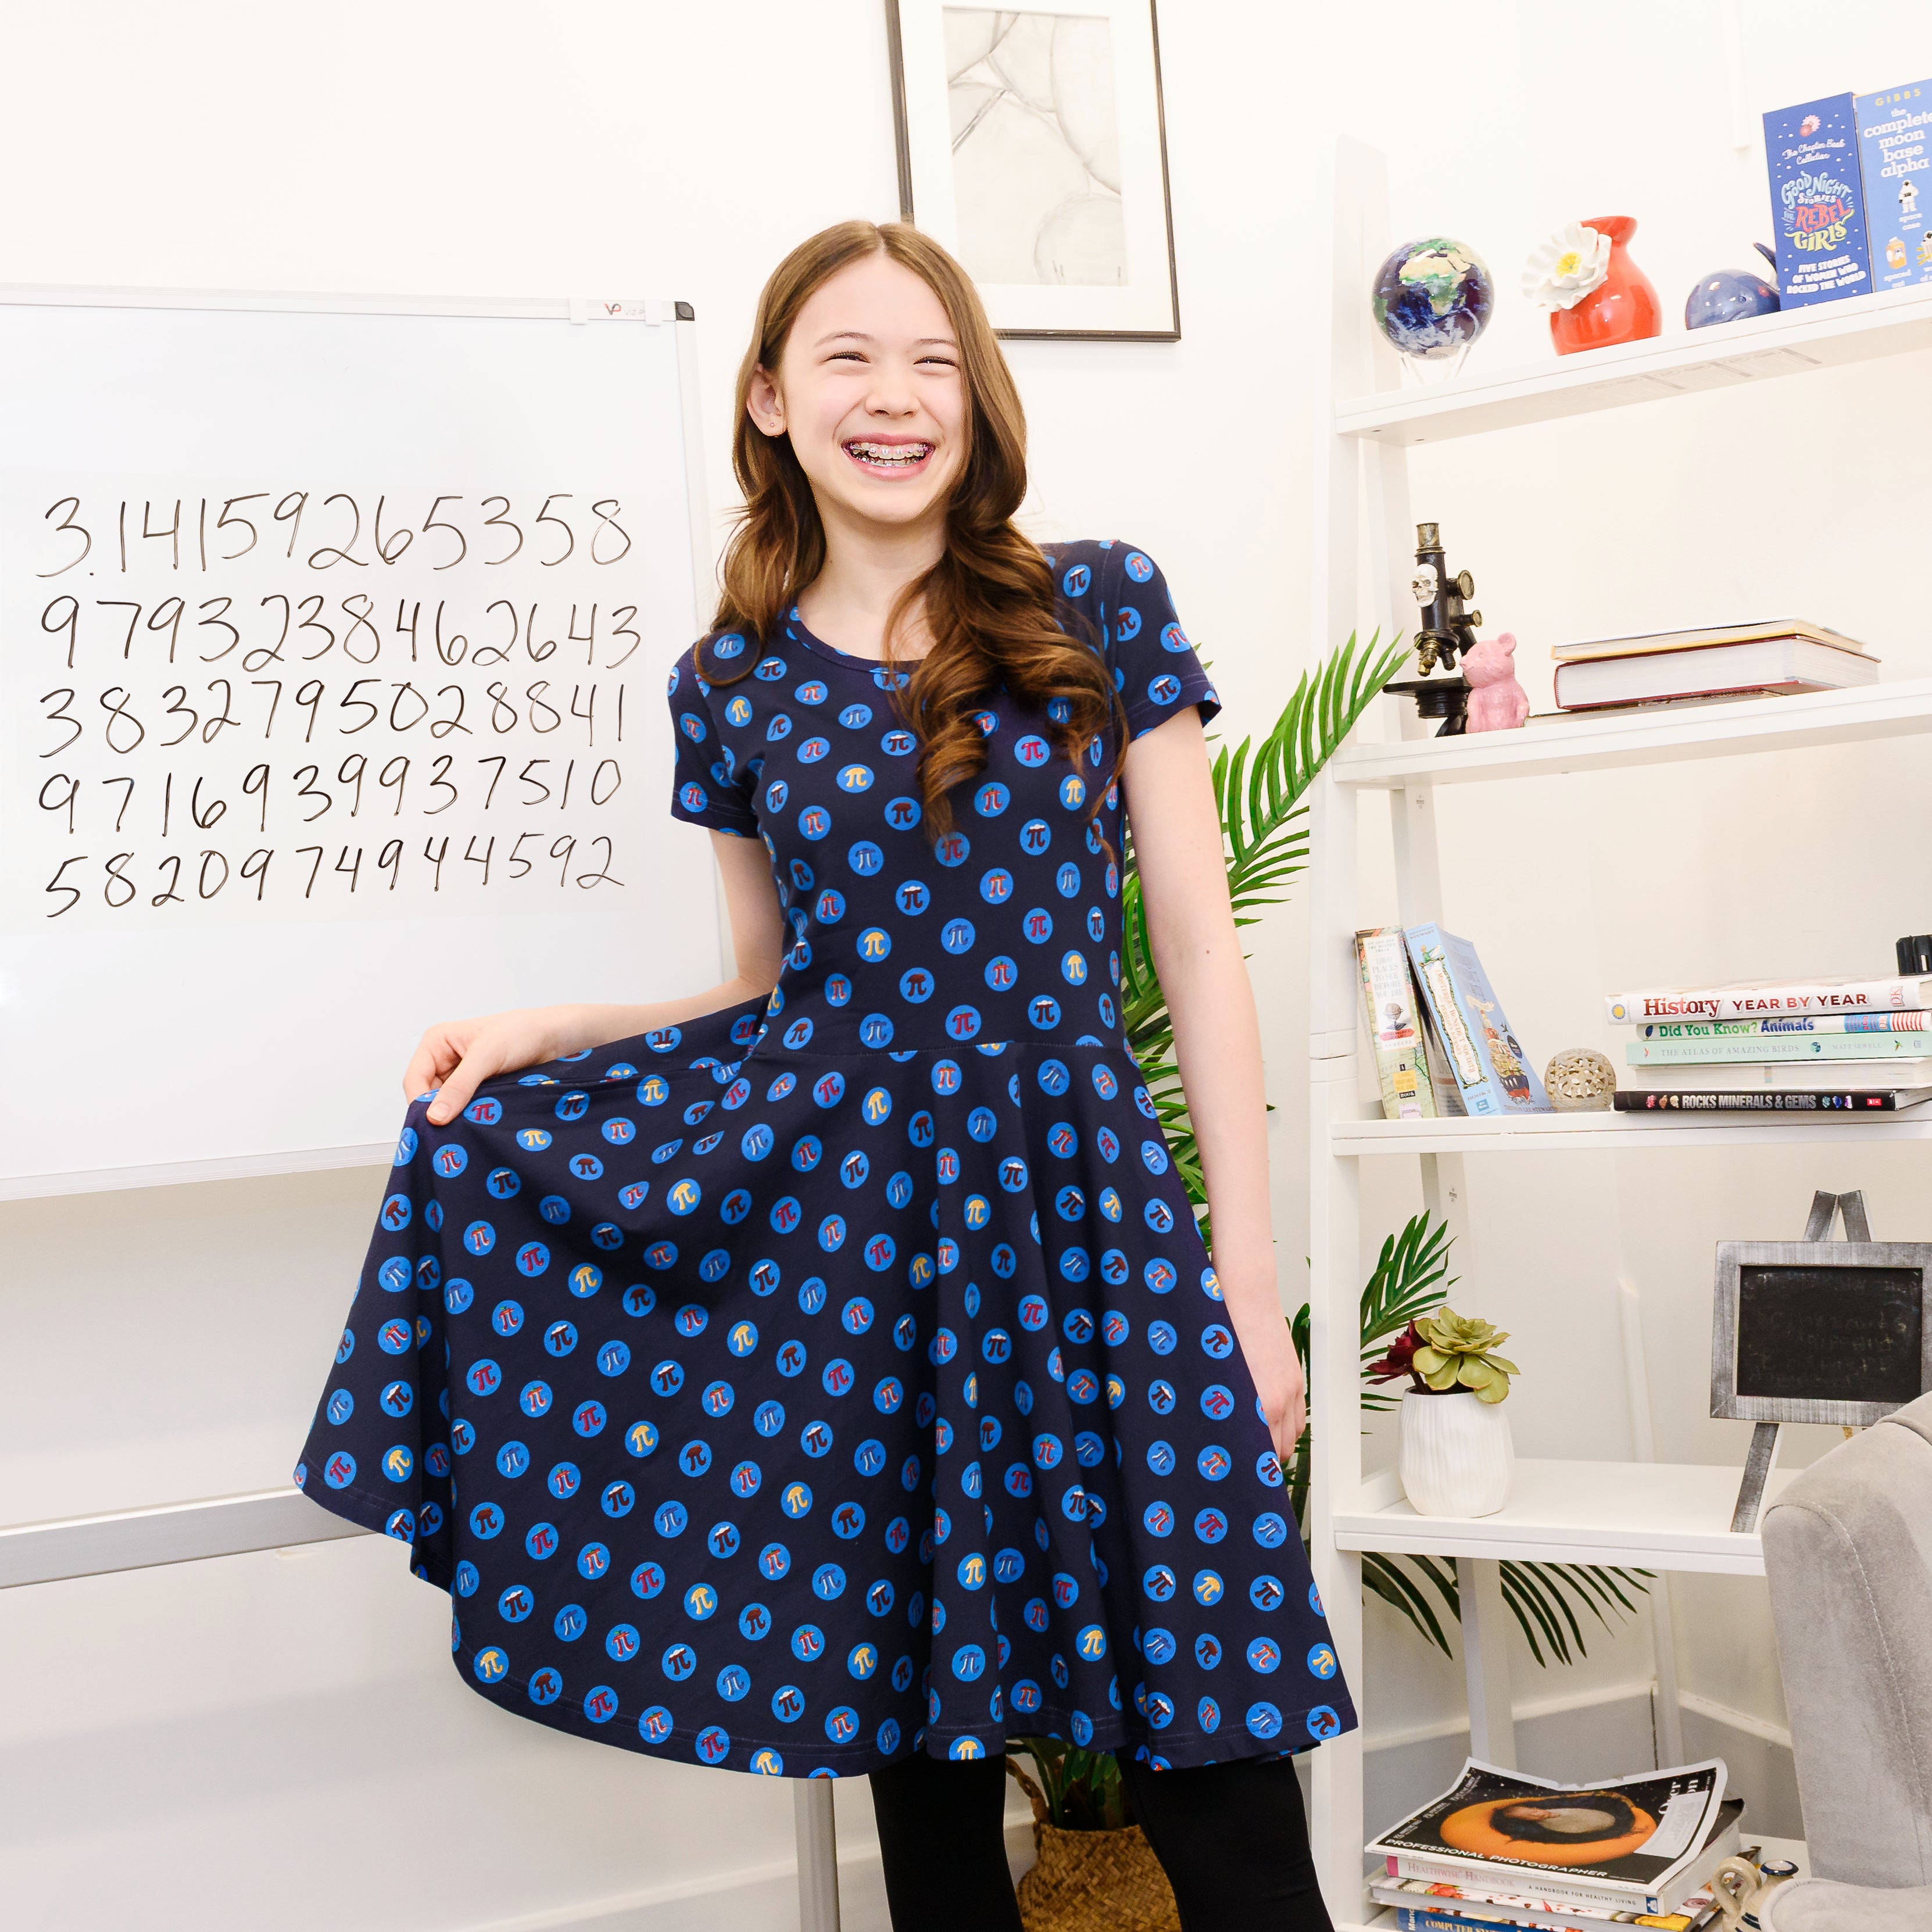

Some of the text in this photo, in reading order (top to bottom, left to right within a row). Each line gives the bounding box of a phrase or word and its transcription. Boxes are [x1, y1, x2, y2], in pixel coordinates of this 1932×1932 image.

[1874, 88, 1922, 107] GIBBS
[1891, 108, 1907, 117] the
[1879, 129, 1926, 149] moon
[1781, 138, 1846, 160] The Chapter Book
[1796, 152, 1831, 165] Collection
[1882, 145, 1924, 163] base
[1880, 158, 1930, 178] alpha
[1797, 192, 1837, 205] STORIES
[1794, 198, 1851, 233] REBEL
[1792, 262, 1859, 284] OF WOMEN WHO
[1798, 255, 1851, 273] FIVE STORIES
[1786, 270, 1867, 295] ROCKED THE WORLD
[1643, 993, 1868, 1018] History YEAR BY YEAR
[1890, 986, 1902, 1006] DK
[1658, 1018, 1815, 1037] Did You Know? Animals
[1726, 1046, 1769, 1054] AMAZING
[1773, 1044, 1799, 1053] BIRDS
[1682, 1095, 1816, 1109] ROCKS MINERALS & GEMS
[1385, 1839, 1485, 1859] PROFESSIONAL
[1489, 1855, 1608, 1877] PHOTOGRAPHER
[1535, 1886, 1569, 1895] HANDBOOK
[1586, 1893, 1612, 1902] HEALTHY
[1615, 1898, 1637, 1906] LIVING
[1425, 1919, 1473, 1932] COMPUTER
